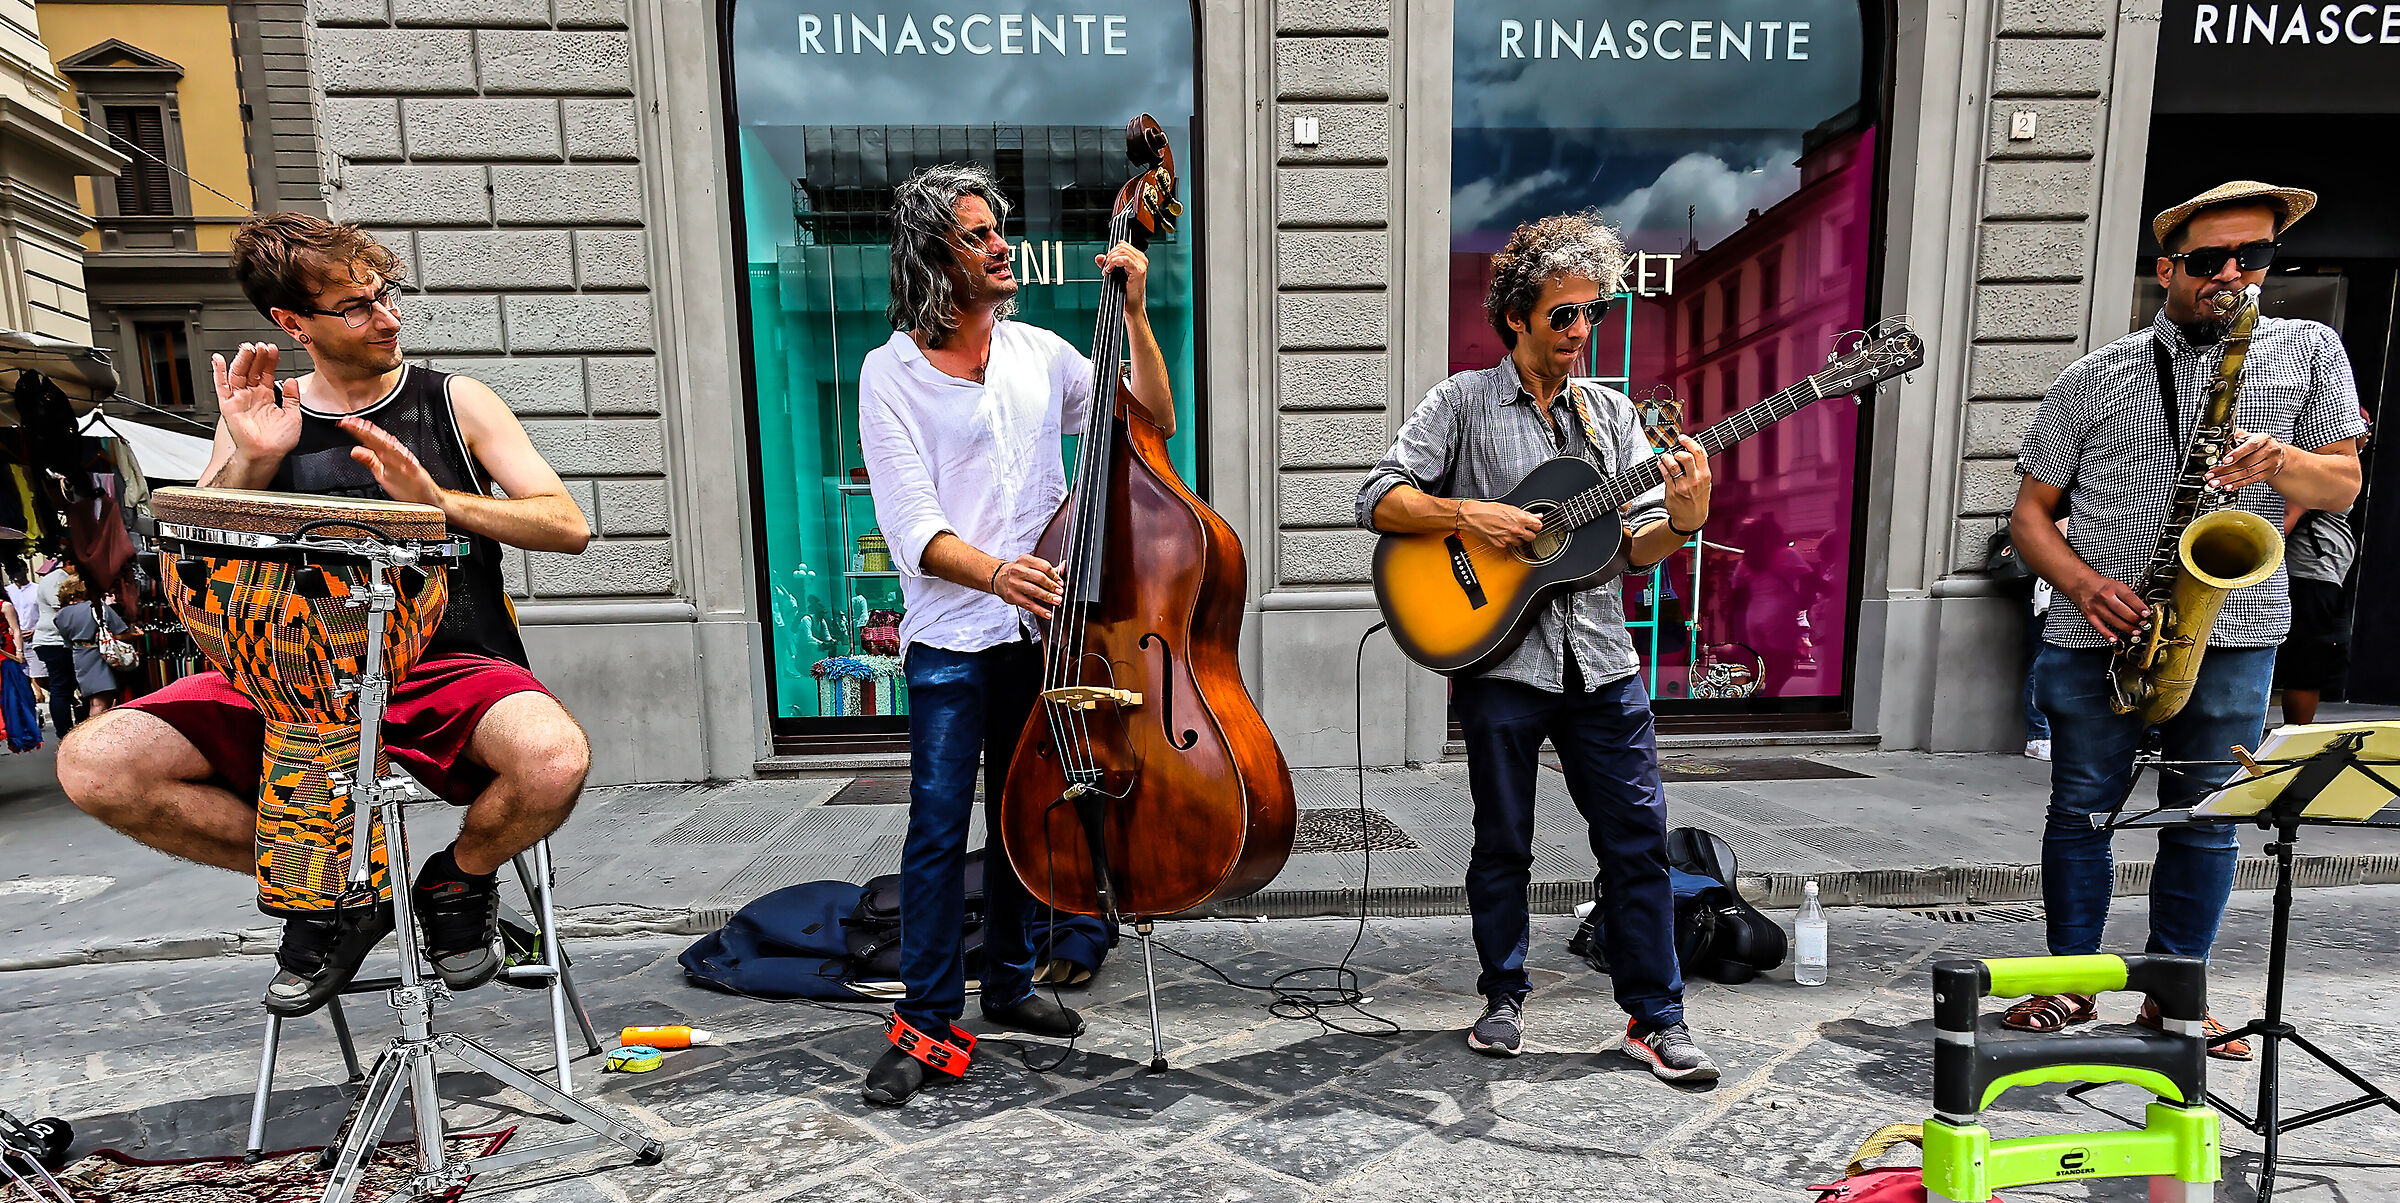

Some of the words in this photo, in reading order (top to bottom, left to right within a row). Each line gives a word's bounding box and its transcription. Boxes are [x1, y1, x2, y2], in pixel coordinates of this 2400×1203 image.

[797, 12, 1127, 57] RINASCENTE
[1500, 19, 1810, 61] RINASCENTE
[2193, 3, 2400, 45] RINASCE
[2019, 117, 2028, 132] 2
[2056, 1168, 2096, 1177] STANDERS
